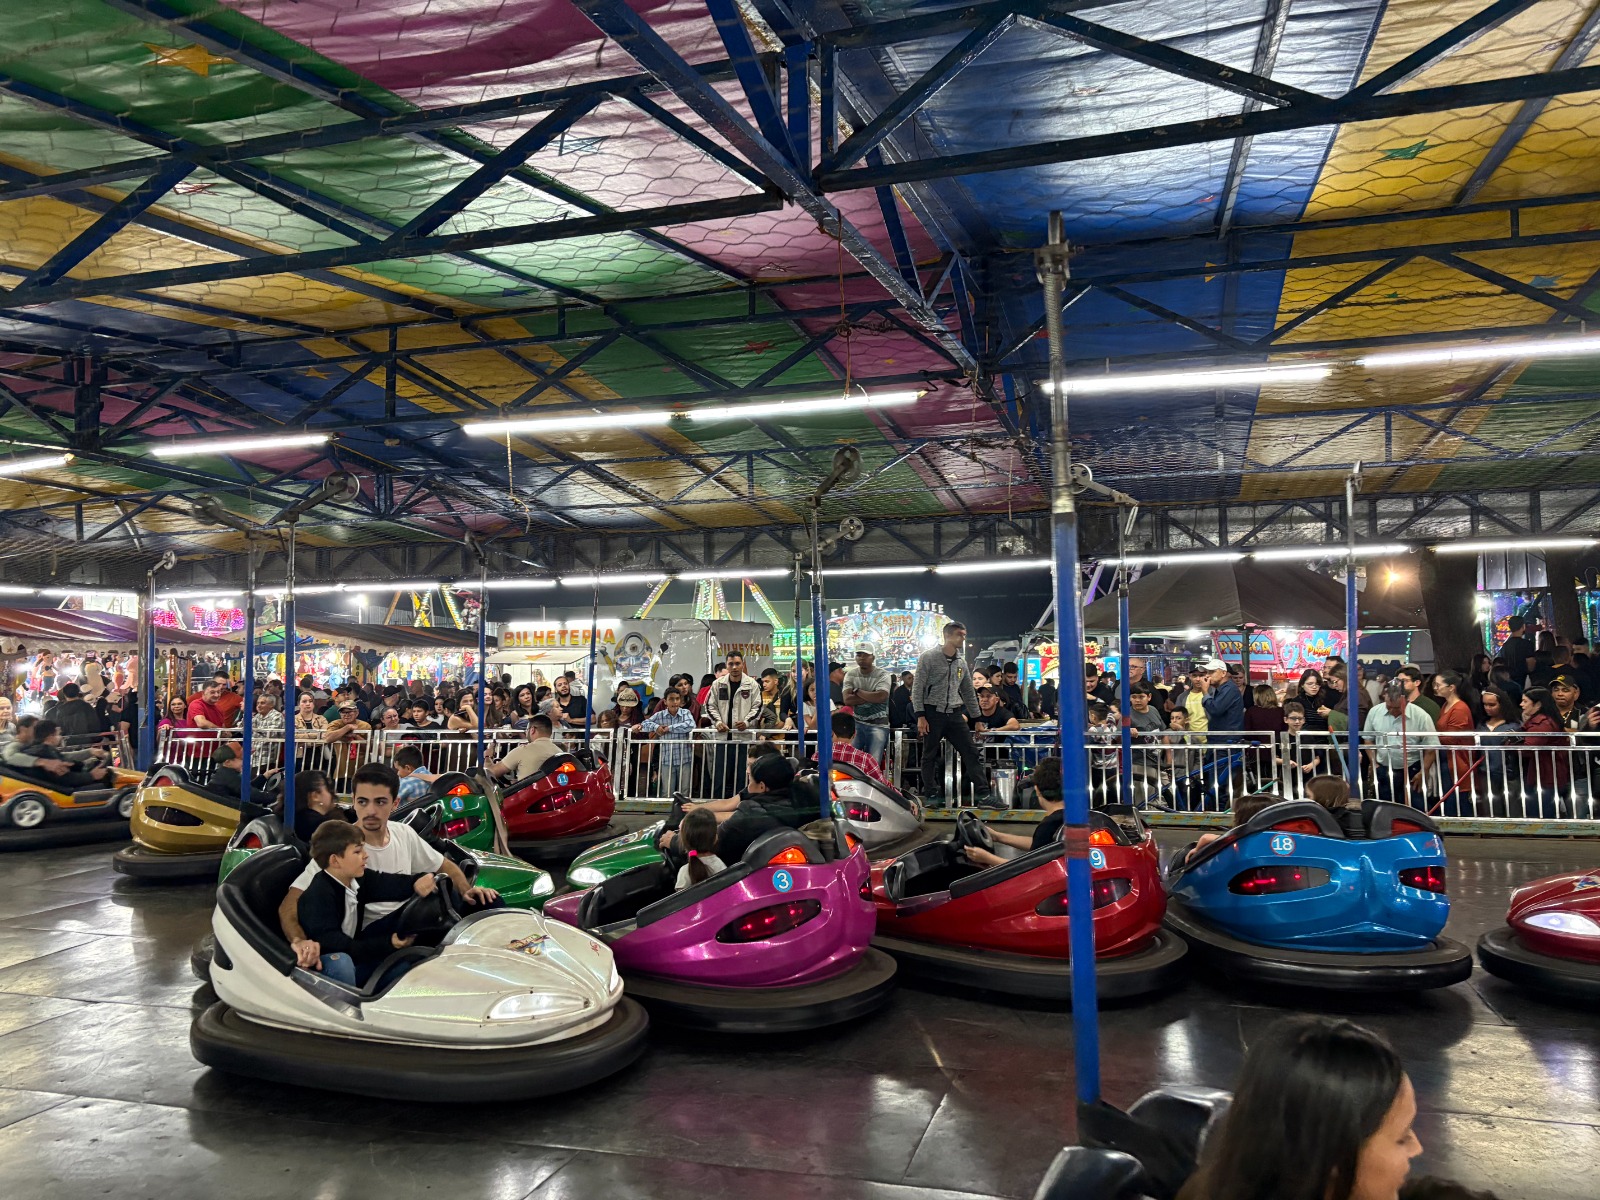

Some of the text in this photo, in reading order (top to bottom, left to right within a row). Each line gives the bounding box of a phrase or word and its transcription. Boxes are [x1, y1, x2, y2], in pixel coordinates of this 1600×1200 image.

[830, 600, 885, 618] CRAZY
[503, 627, 616, 647] BILHETERIA
[1218, 641, 1273, 655] PIPCA
[557, 774, 568, 785] 11
[452, 798, 463, 811] 1
[1271, 836, 1294, 852] 18
[1090, 850, 1103, 867] 9
[777, 872, 790, 890] 3
